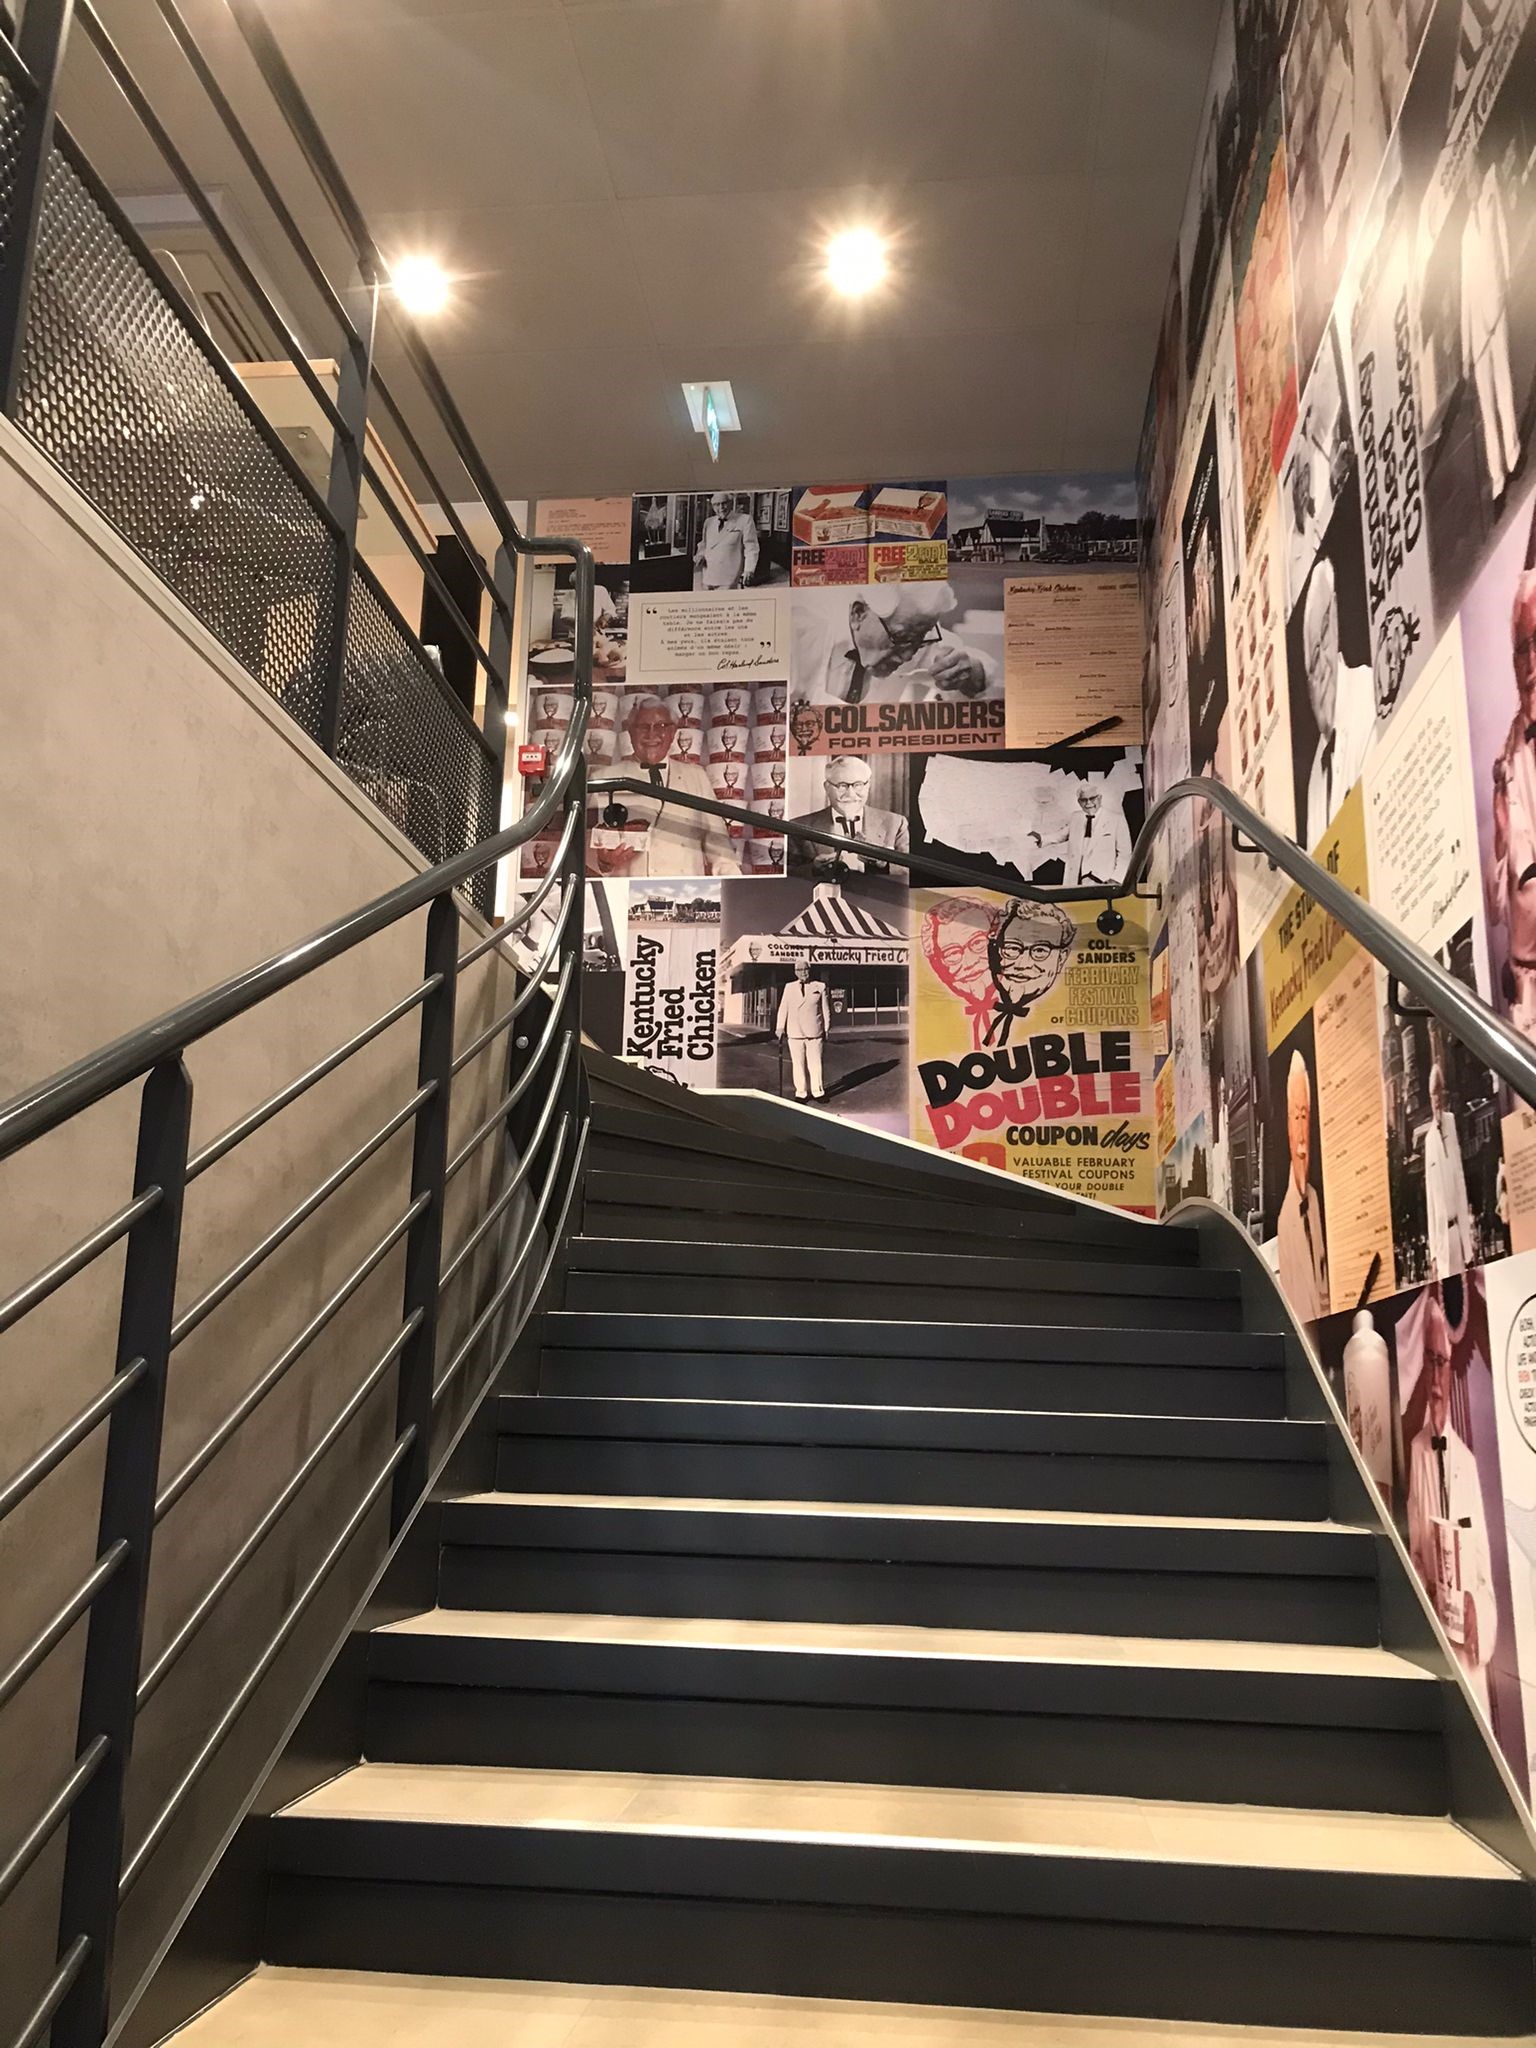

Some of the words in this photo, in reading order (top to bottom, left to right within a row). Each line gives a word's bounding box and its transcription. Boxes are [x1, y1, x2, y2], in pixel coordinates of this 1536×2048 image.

[1393, 290, 1422, 554] Chicken
[1358, 351, 1386, 626] Kentucky
[1378, 408, 1403, 592] Fried
[794, 550, 825, 565] FREE
[873, 546, 906, 562] FREE
[907, 544, 918, 561] 2
[939, 543, 947, 560] 1
[829, 737, 871, 749] FOR
[878, 732, 1002, 748] PRESIDENT
[1278, 911, 1294, 954] THE
[1087, 939, 1117, 951] COL.
[808, 948, 861, 964] Kentucky
[865, 949, 894, 962] Fried
[1077, 951, 1136, 964] SANDERS
[1064, 965, 1140, 986] FEBRUARY
[1270, 961, 1303, 1034] Kentucky
[1301, 922, 1325, 990] Fried
[626, 934, 664, 1060] Kentucky
[687, 949, 716, 1061] Chicken
[1069, 985, 1137, 1006] FESTIVAL
[657, 986, 685, 1060] Fried
[1050, 1016, 1064, 1024] OF
[1064, 1006, 1140, 1026] COUPONS
[917, 1031, 1131, 1109] DOUBLE
[925, 1071, 1141, 1149] DOUBLE
[1006, 1125, 1099, 1146] COUPON
[1100, 1120, 1150, 1153] days
[1013, 1156, 1072, 1167] VALUABLE
[1076, 1156, 1136, 1168] FEBRUARY
[1022, 1169, 1073, 1180] FESTIVAL
[1078, 1168, 1135, 1180] COUPONS
[1055, 1182, 1082, 1191] YOUR
[1087, 1182, 1124, 1191] DOUBLE
